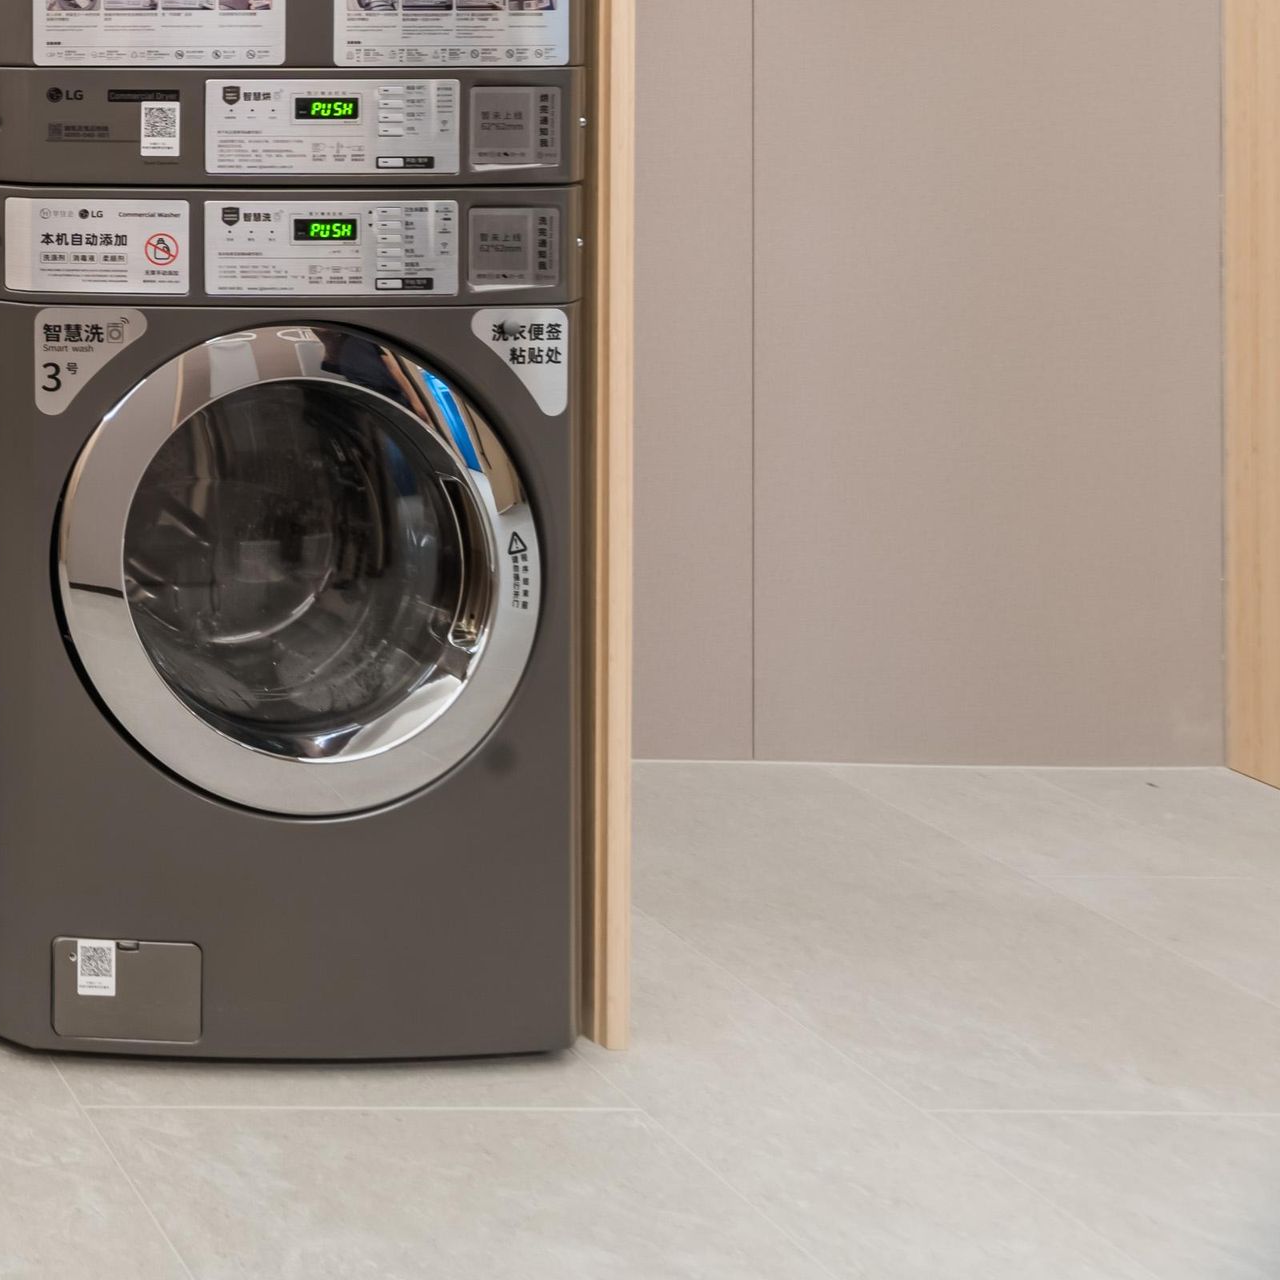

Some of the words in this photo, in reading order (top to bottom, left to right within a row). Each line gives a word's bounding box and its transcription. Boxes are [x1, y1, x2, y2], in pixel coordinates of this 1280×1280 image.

[66, 90, 83, 100] LG
[310, 102, 353, 116] PUSH
[91, 210, 103, 218] LG
[310, 223, 352, 237] PUSH
[40, 232, 127, 246] 本机自动添加
[43, 324, 104, 343] 智慧洗
[43, 344, 68, 353] Smart
[72, 344, 94, 353] wash
[509, 347, 562, 365] 粘贴处
